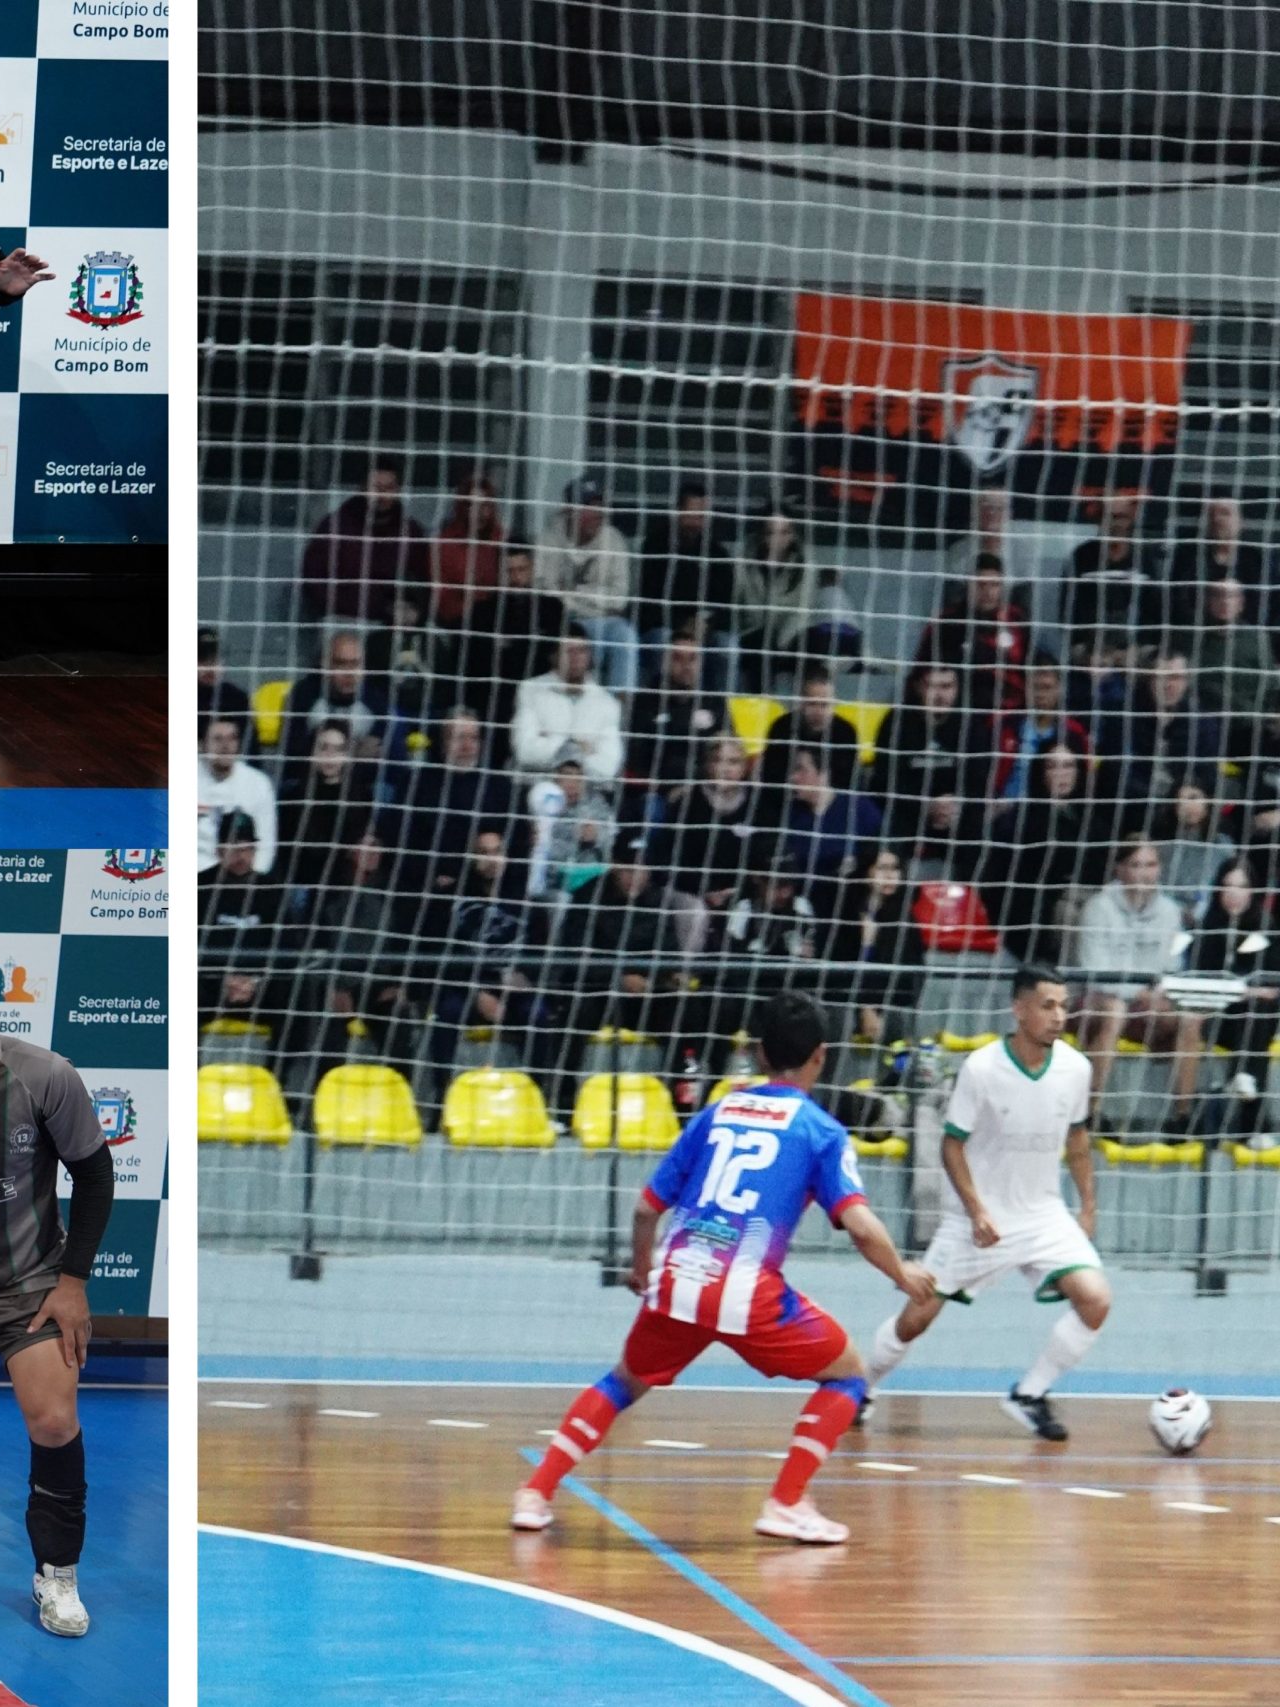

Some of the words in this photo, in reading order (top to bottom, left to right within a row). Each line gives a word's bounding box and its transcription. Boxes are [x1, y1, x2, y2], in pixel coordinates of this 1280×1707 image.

[73, 1, 148, 19] Município
[73, 23, 129, 41] Campo
[133, 24, 168, 38] Bom
[63, 135, 142, 152] Secretaria
[146, 137, 166, 152] de
[52, 154, 115, 173] Esporte
[117, 157, 128, 170] e
[130, 155, 168, 171] Laze
[54, 338, 130, 356] Município
[133, 339, 152, 353] de
[54, 359, 109, 376] Campo
[114, 360, 149, 373] Bom
[45, 461, 122, 477] Secretaria
[127, 462, 147, 477] de
[34, 480, 96, 497] Esporte
[99, 483, 109, 495] e
[111, 480, 156, 495] Lazer
[29, 855, 45, 868] de
[6, 873, 14, 883] e
[16, 870, 52, 884] Lazer
[91, 888, 151, 904] Município
[154, 889, 168, 902] de
[90, 906, 135, 920] Campo
[138, 907, 167, 919] Bom
[78, 996, 142, 1010] Secretaria
[145, 997, 160, 1010] de
[9, 1009, 20, 1017] de
[68, 1011, 120, 1027] Esporte
[122, 1014, 131, 1024] e
[133, 1013, 167, 1025] Lazer
[0, 1021, 31, 1033] BOM
[126, 1154, 141, 1167] de
[697, 1126, 781, 1216] 12
[117, 1251, 133, 1264] de
[94, 1267, 102, 1277] e
[105, 1265, 140, 1278] Lazer
